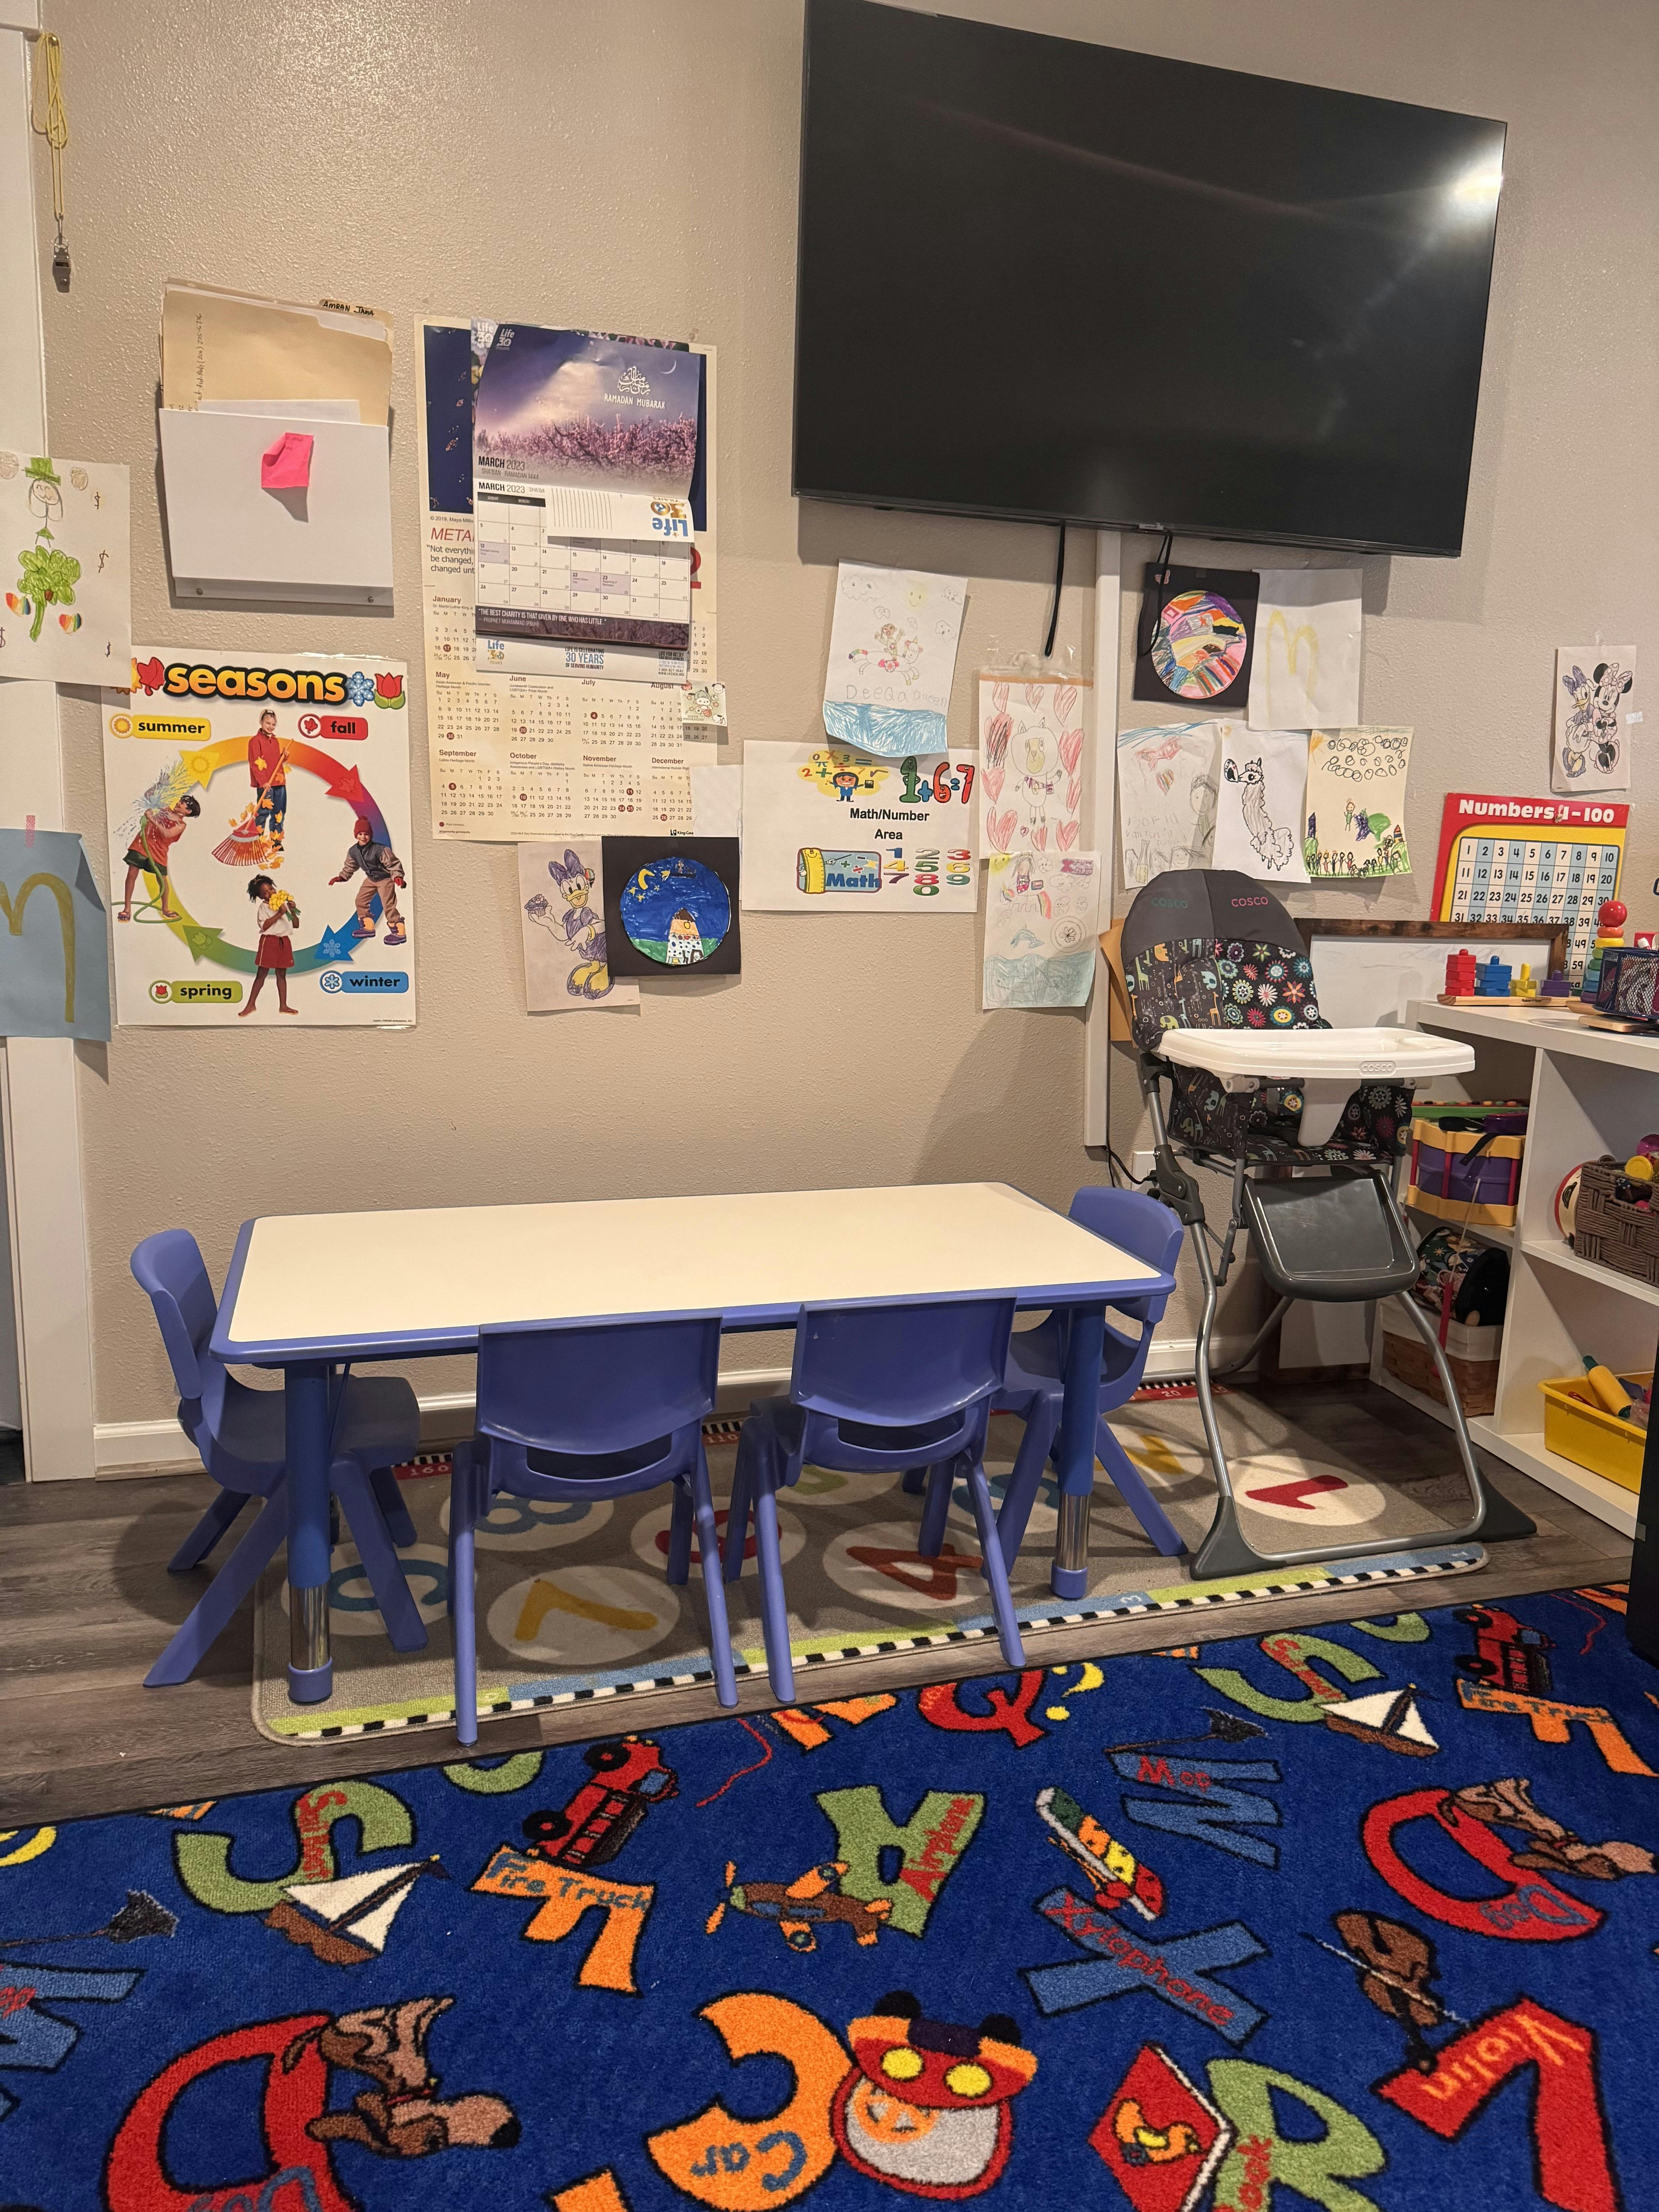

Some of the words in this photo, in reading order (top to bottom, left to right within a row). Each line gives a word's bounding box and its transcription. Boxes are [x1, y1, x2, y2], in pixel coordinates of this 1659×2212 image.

[477, 322, 494, 333] Life
[500, 328, 515, 338] Life
[605, 393, 633, 405] RAMADAN
[637, 398, 665, 409] MUBARAK
[479, 456, 505, 468] MARCH
[507, 460, 525, 471] 2023
[479, 482, 505, 491] MARCH
[507, 484, 525, 493] 2023
[431, 527, 474, 542] META
[652, 518, 688, 538] Life
[441, 555, 474, 565] changed,
[431, 565, 461, 574] changed
[433, 596, 461, 604] January
[488, 640, 505, 650] Life
[566, 652, 576, 662] 30
[579, 653, 604, 664] YEARS
[166, 663, 346, 703] seasons
[138, 721, 205, 734] summer
[330, 721, 356, 734] fall
[802, 768, 812, 777] 2
[850, 808, 930, 821] Math/Number
[1459, 799, 1554, 820] Numbers
[874, 828, 903, 840] Area
[886, 847, 903, 858] 1
[915, 848, 940, 860] 2
[947, 848, 971, 860] 3
[1467, 845, 1471, 854] 1
[1482, 846, 1489, 855] 2
[1498, 847, 1504, 856] 3
[1513, 848, 1520, 857] 4
[1529, 848, 1535, 858] 5
[1545, 849, 1551, 859] 6
[1561, 850, 1567, 859] 7
[1576, 851, 1582, 860] 8
[1591, 852, 1597, 861] 9
[1605, 852, 1614, 862] 10
[883, 860, 908, 871] 4
[914, 861, 939, 872] 5
[946, 862, 970, 873] 6
[826, 873, 881, 888] Math
[883, 872, 909, 884] 7
[914, 874, 939, 885] 8
[946, 874, 970, 886] 9
[1462, 867, 1470, 877] 11
[1478, 869, 1487, 878] 12
[1494, 869, 1503, 879] 13
[1510, 870, 1518, 880] 14
[1525, 871, 1535, 880] 15
[1540, 871, 1550, 881] 16
[1556, 872, 1566, 882] 17
[1572, 873, 1580, 883] 18
[1587, 874, 1595, 884] 19
[1601, 874, 1613, 884] 20
[913, 885, 939, 896] 0
[1151, 898, 1188, 909] COSCO
[1231, 896, 1268, 907] COSCO
[349, 975, 401, 987] winter
[180, 984, 232, 1000] spring
[1362, 1064, 1393, 1072] COSCO
[486, 1851, 545, 1893] Fire
[559, 1876, 652, 1912] Truck
[1479, 1883, 1592, 1930] Dog
[1043, 1893, 1235, 2026] Xylophone
[1421, 2014, 1585, 2100] Violin
[690, 2130, 808, 2193] Car
